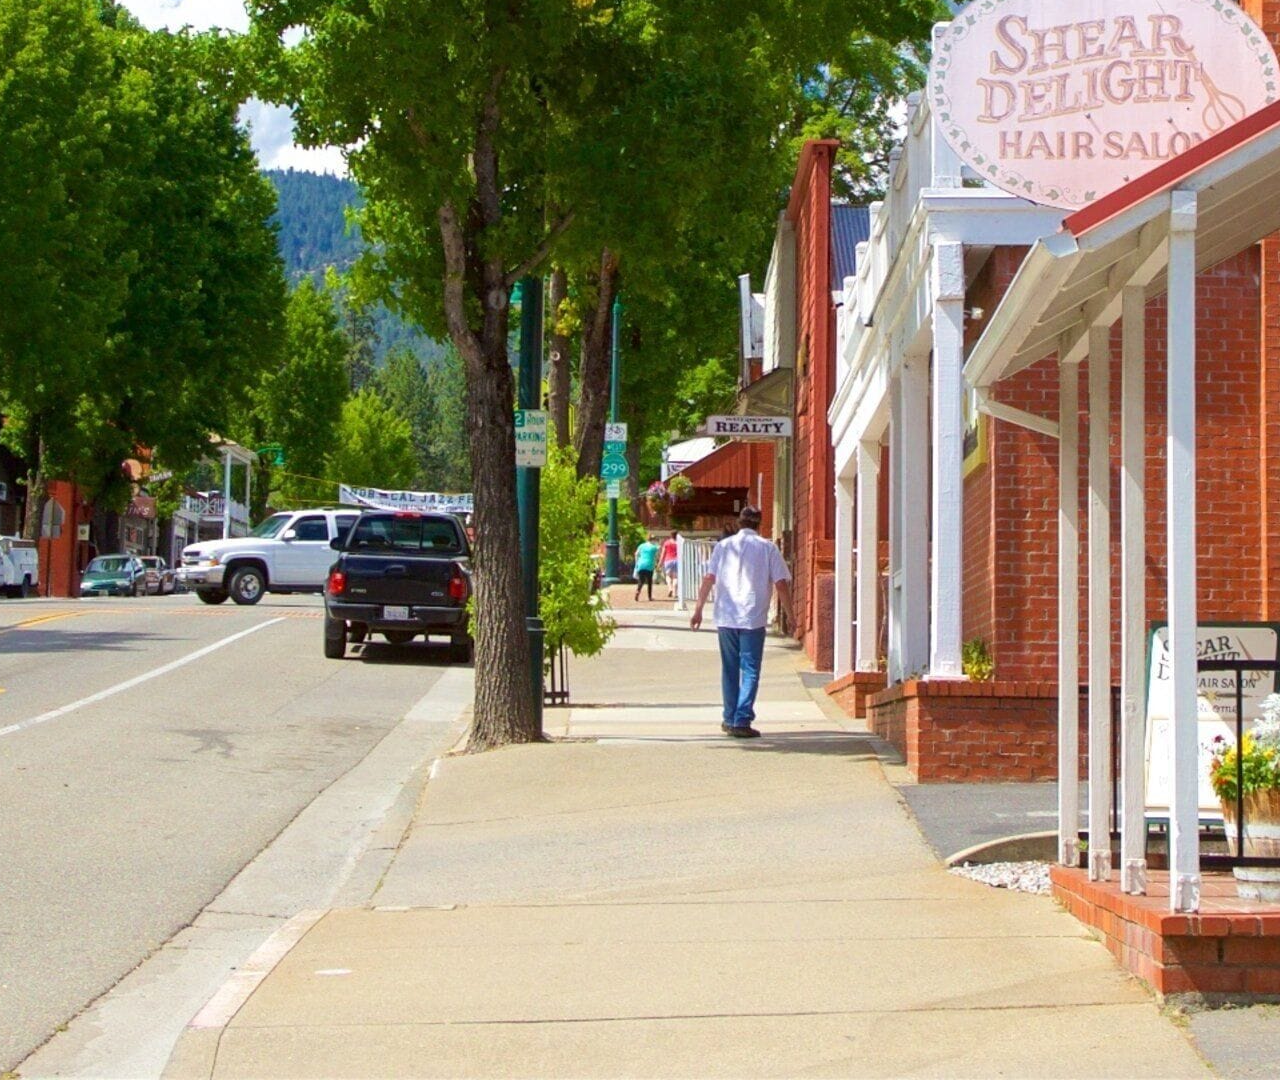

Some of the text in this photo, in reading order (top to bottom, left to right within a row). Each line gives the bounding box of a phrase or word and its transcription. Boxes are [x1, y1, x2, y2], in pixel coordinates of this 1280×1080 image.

[989, 14, 1195, 76] SHEAR
[977, 59, 1202, 123] DELIGHT
[998, 130, 1096, 160] HAIR
[514, 412, 523, 425] 2
[715, 421, 784, 434] REALTY
[516, 432, 546, 442] ARKING
[601, 463, 626, 475] 299
[1196, 677, 1257, 689] AIR SAON
